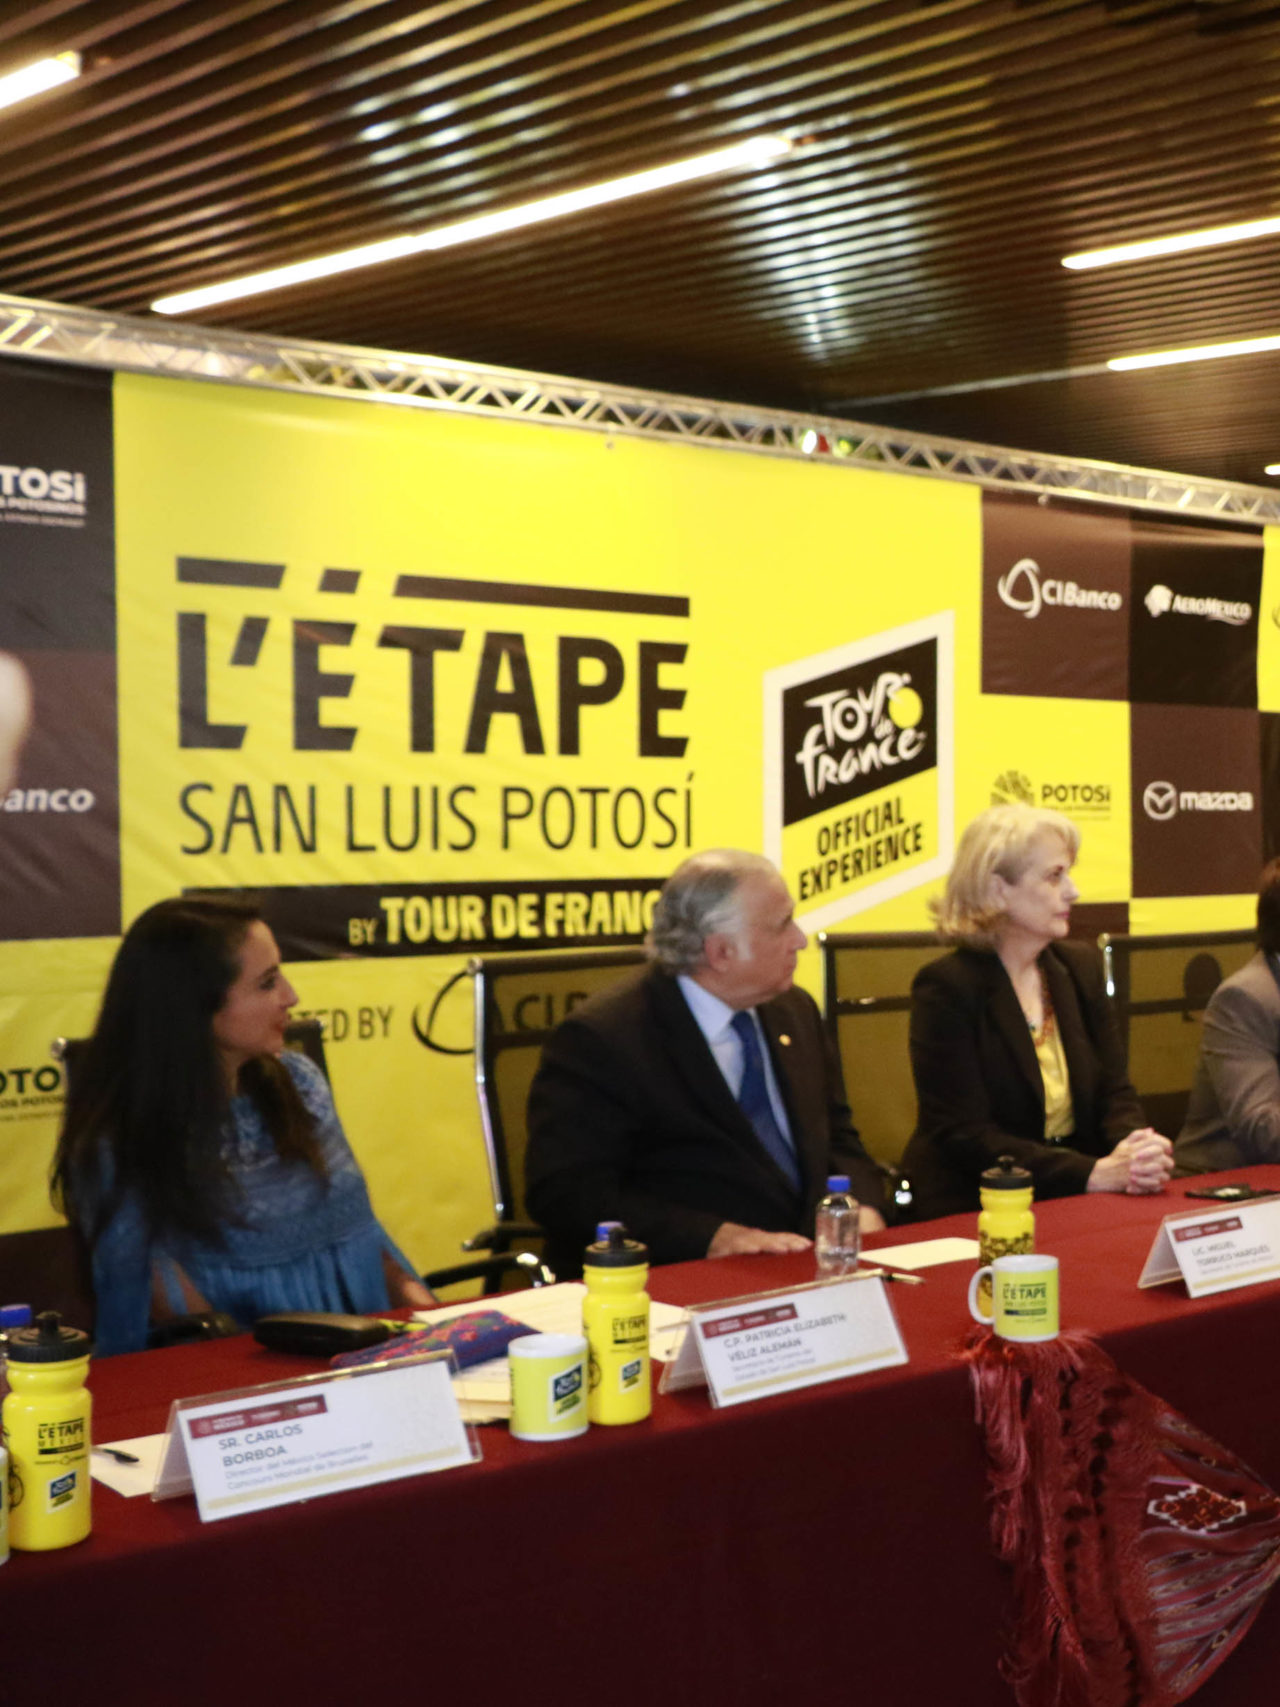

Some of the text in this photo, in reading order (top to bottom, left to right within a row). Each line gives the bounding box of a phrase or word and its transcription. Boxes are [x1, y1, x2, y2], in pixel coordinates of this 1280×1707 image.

[1042, 579, 1122, 611] CIBanco
[0, 788, 94, 813] anco
[179, 771, 695, 855] SAN LUIS POTOSÍ
[1180, 791, 1253, 811] mazda
[818, 796, 905, 857] OFFICIAL
[799, 822, 924, 902] EXPERIENCE
[348, 889, 659, 947] BY TOUR DE FRANC
[358, 1004, 394, 1041] BY
[743, 1327, 792, 1344] PATRICIA
[218, 1423, 303, 1451] SR. CARLOS
[222, 1444, 288, 1468] BORBOA
